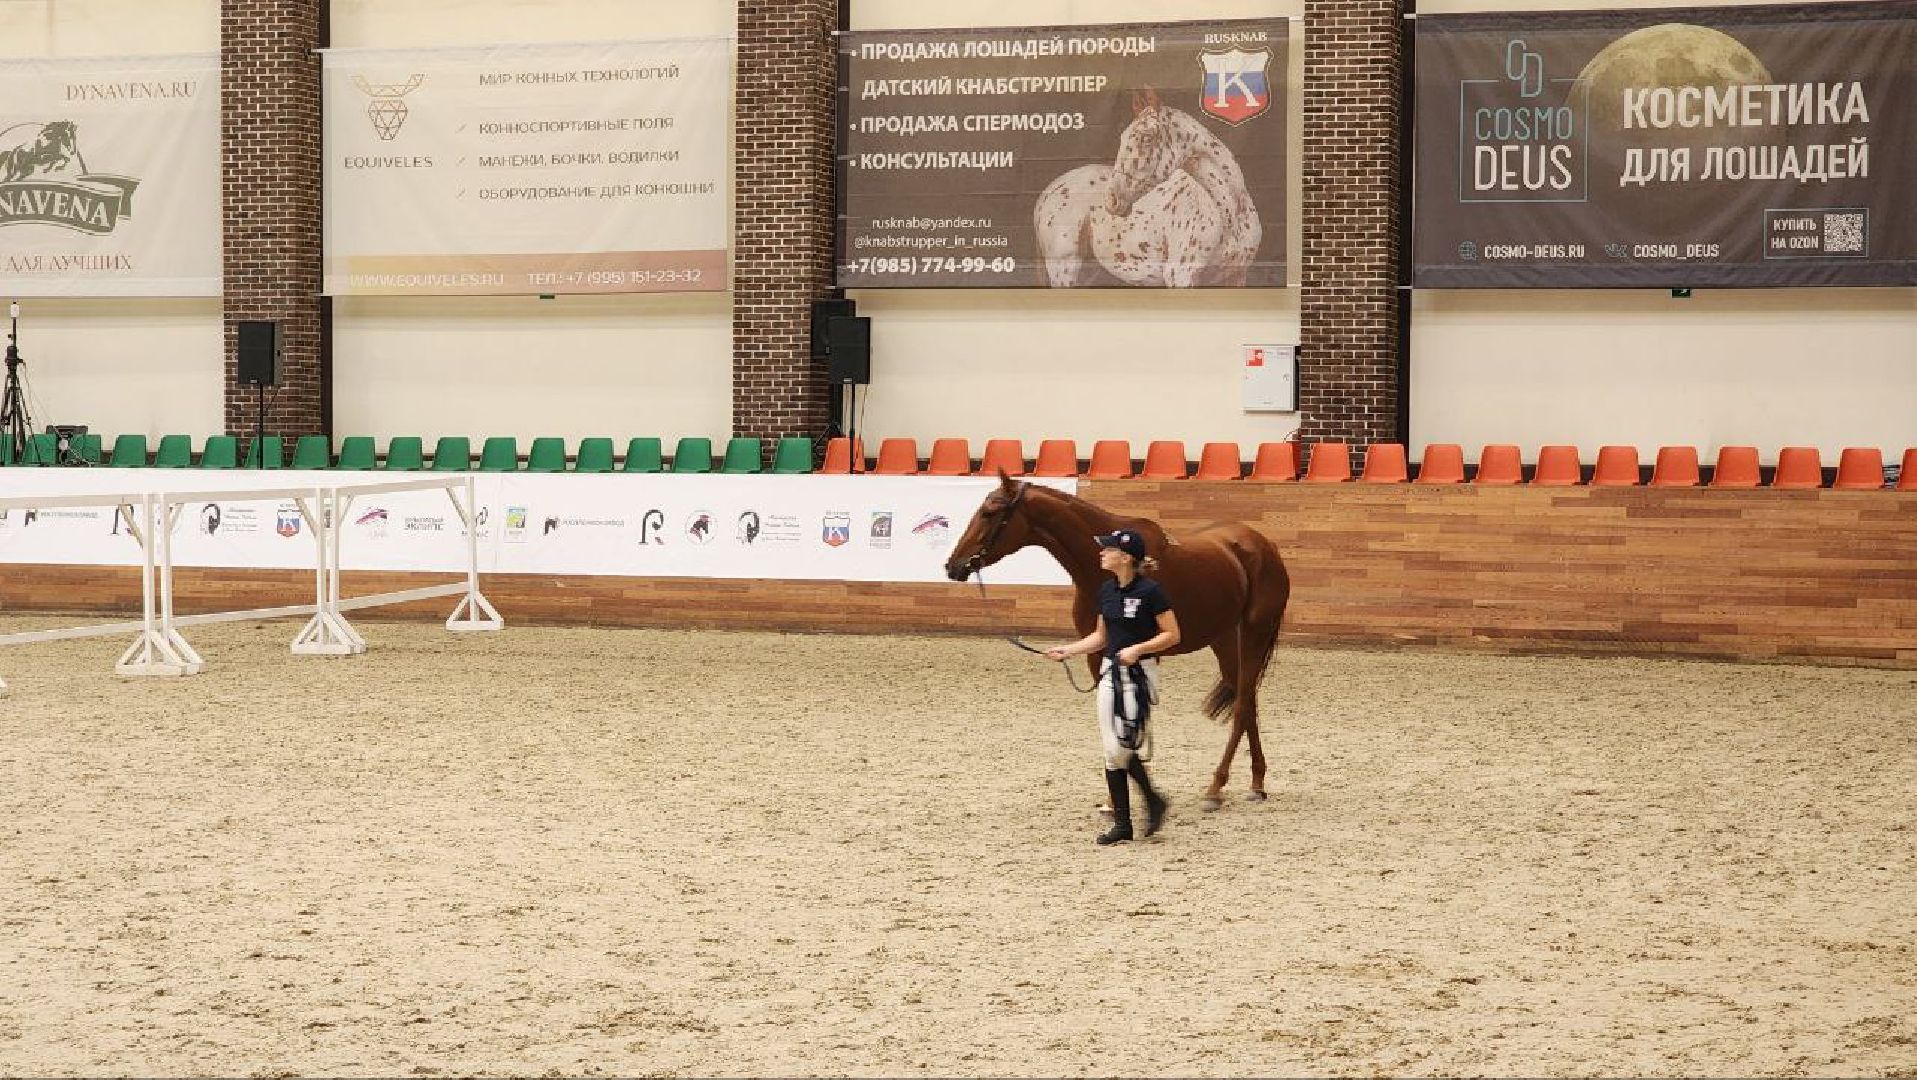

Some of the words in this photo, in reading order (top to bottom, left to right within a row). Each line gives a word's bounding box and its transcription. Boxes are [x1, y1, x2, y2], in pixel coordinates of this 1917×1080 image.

[861, 41, 960, 61] ПРОДАЖА
[962, 36, 1064, 59] ЛОШАДЕЙ
[1068, 37, 1155, 57] ПОРОДЫ
[479, 73, 513, 86] МИР
[515, 72, 578, 84] КОННЫХ
[582, 65, 680, 81] ТЕХНОЛОГИЙ
[66, 82, 197, 100] DYNAVENA.RU
[862, 75, 952, 99] ДАТСКИЙ
[956, 76, 1107, 96] КНАБСТРУППЕР
[1622, 82, 1870, 129] КОСМЕТИКА
[479, 119, 630, 134] КОННОСПОРТИВНЫЕ
[632, 118, 674, 129] ПОЛЯ
[861, 114, 959, 136] ПРОДАЖА
[962, 112, 1085, 134] СПЕРМОДОЗ
[1475, 106, 1573, 141] COSMO
[344, 156, 434, 168] EQUIVELES
[608, 150, 680, 164] ВОДИЛКИ
[861, 152, 1014, 171] КОНСУЛЬТАЦИИ
[1620, 148, 1690, 187] ДЛЯ
[1700, 138, 1868, 183] ЛОШАДЕЙ
[1474, 144, 1573, 191] DEUS
[479, 186, 598, 200] ОБОРУДОВАНИЕ
[600, 185, 631, 197] ДЛЯ
[635, 181, 715, 195] КОНЮШНИ
[872, 217, 992, 230] rusknab@yandex.ru
[1773, 218, 1817, 233] КУПИТЬ
[854, 235, 1008, 249] @knabstrupper_in_russia
[1771, 236, 1787, 248] НА
[1788, 235, 1819, 248] OZON
[1484, 244, 1585, 259] COSMO-DEUS.RU
[1633, 244, 1720, 260] COSMO_DEUS
[6, 255, 43, 273] ДЛЯ
[50, 254, 132, 271] ЛУЧШИХ
[847, 257, 917, 275] +7(985)
[921, 256, 1016, 273] 774-99-60
[350, 273, 505, 287] WWW.EQUIVELES.RU
[587, 270, 625, 285] (995)
[631, 269, 702, 283] 151-23-32
